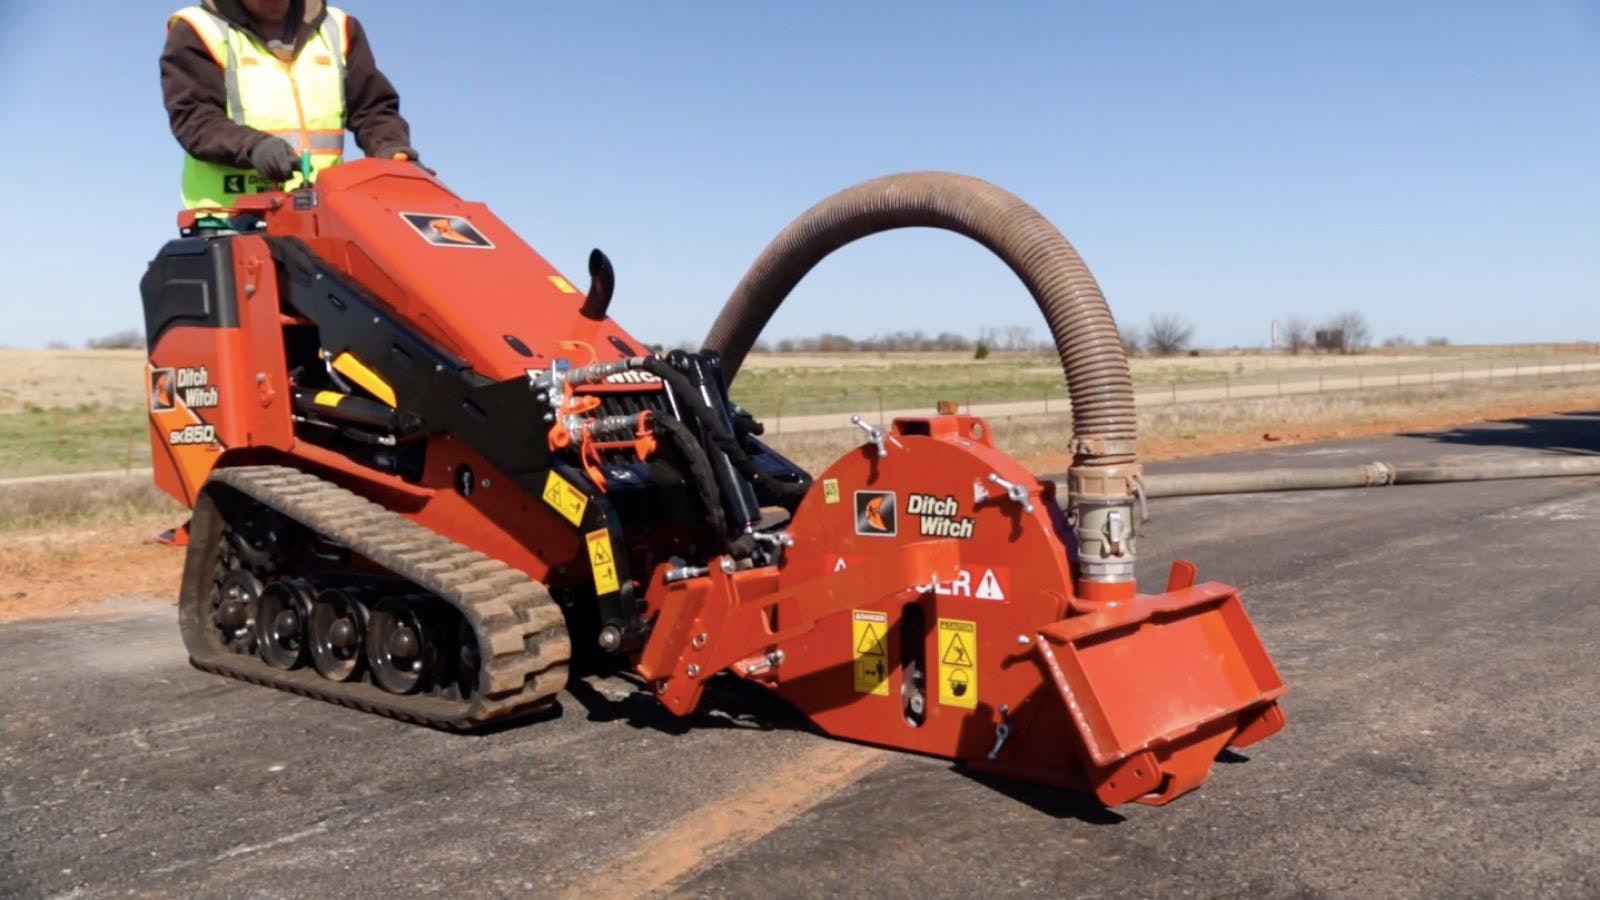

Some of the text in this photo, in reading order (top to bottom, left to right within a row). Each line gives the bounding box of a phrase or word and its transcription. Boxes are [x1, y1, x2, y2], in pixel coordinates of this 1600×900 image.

[177, 367, 208, 388] Ditch
[606, 369, 662, 384] Witc
[185, 387, 218, 408] Witch
[907, 494, 957, 516] Ditch
[920, 516, 973, 539] Witch
